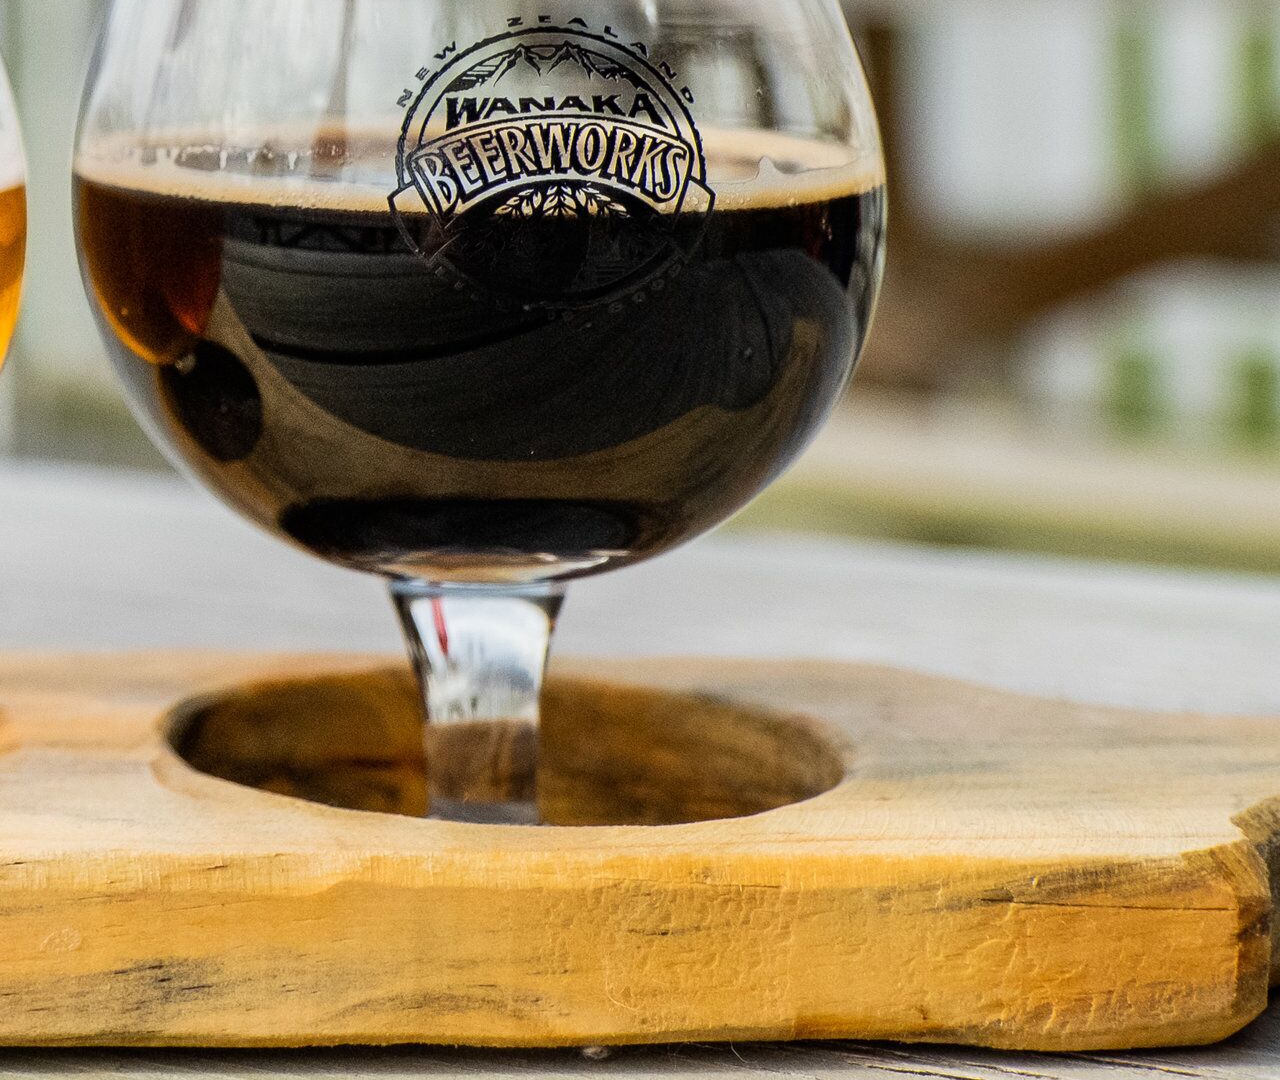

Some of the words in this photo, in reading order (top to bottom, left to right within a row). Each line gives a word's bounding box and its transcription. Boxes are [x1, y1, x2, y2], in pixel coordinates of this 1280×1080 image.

[396, 41, 457, 108] NEW
[507, 14, 696, 104] ZEALAND
[444, 92, 669, 130] WANAKA
[415, 122, 689, 216] BEERWORKS
